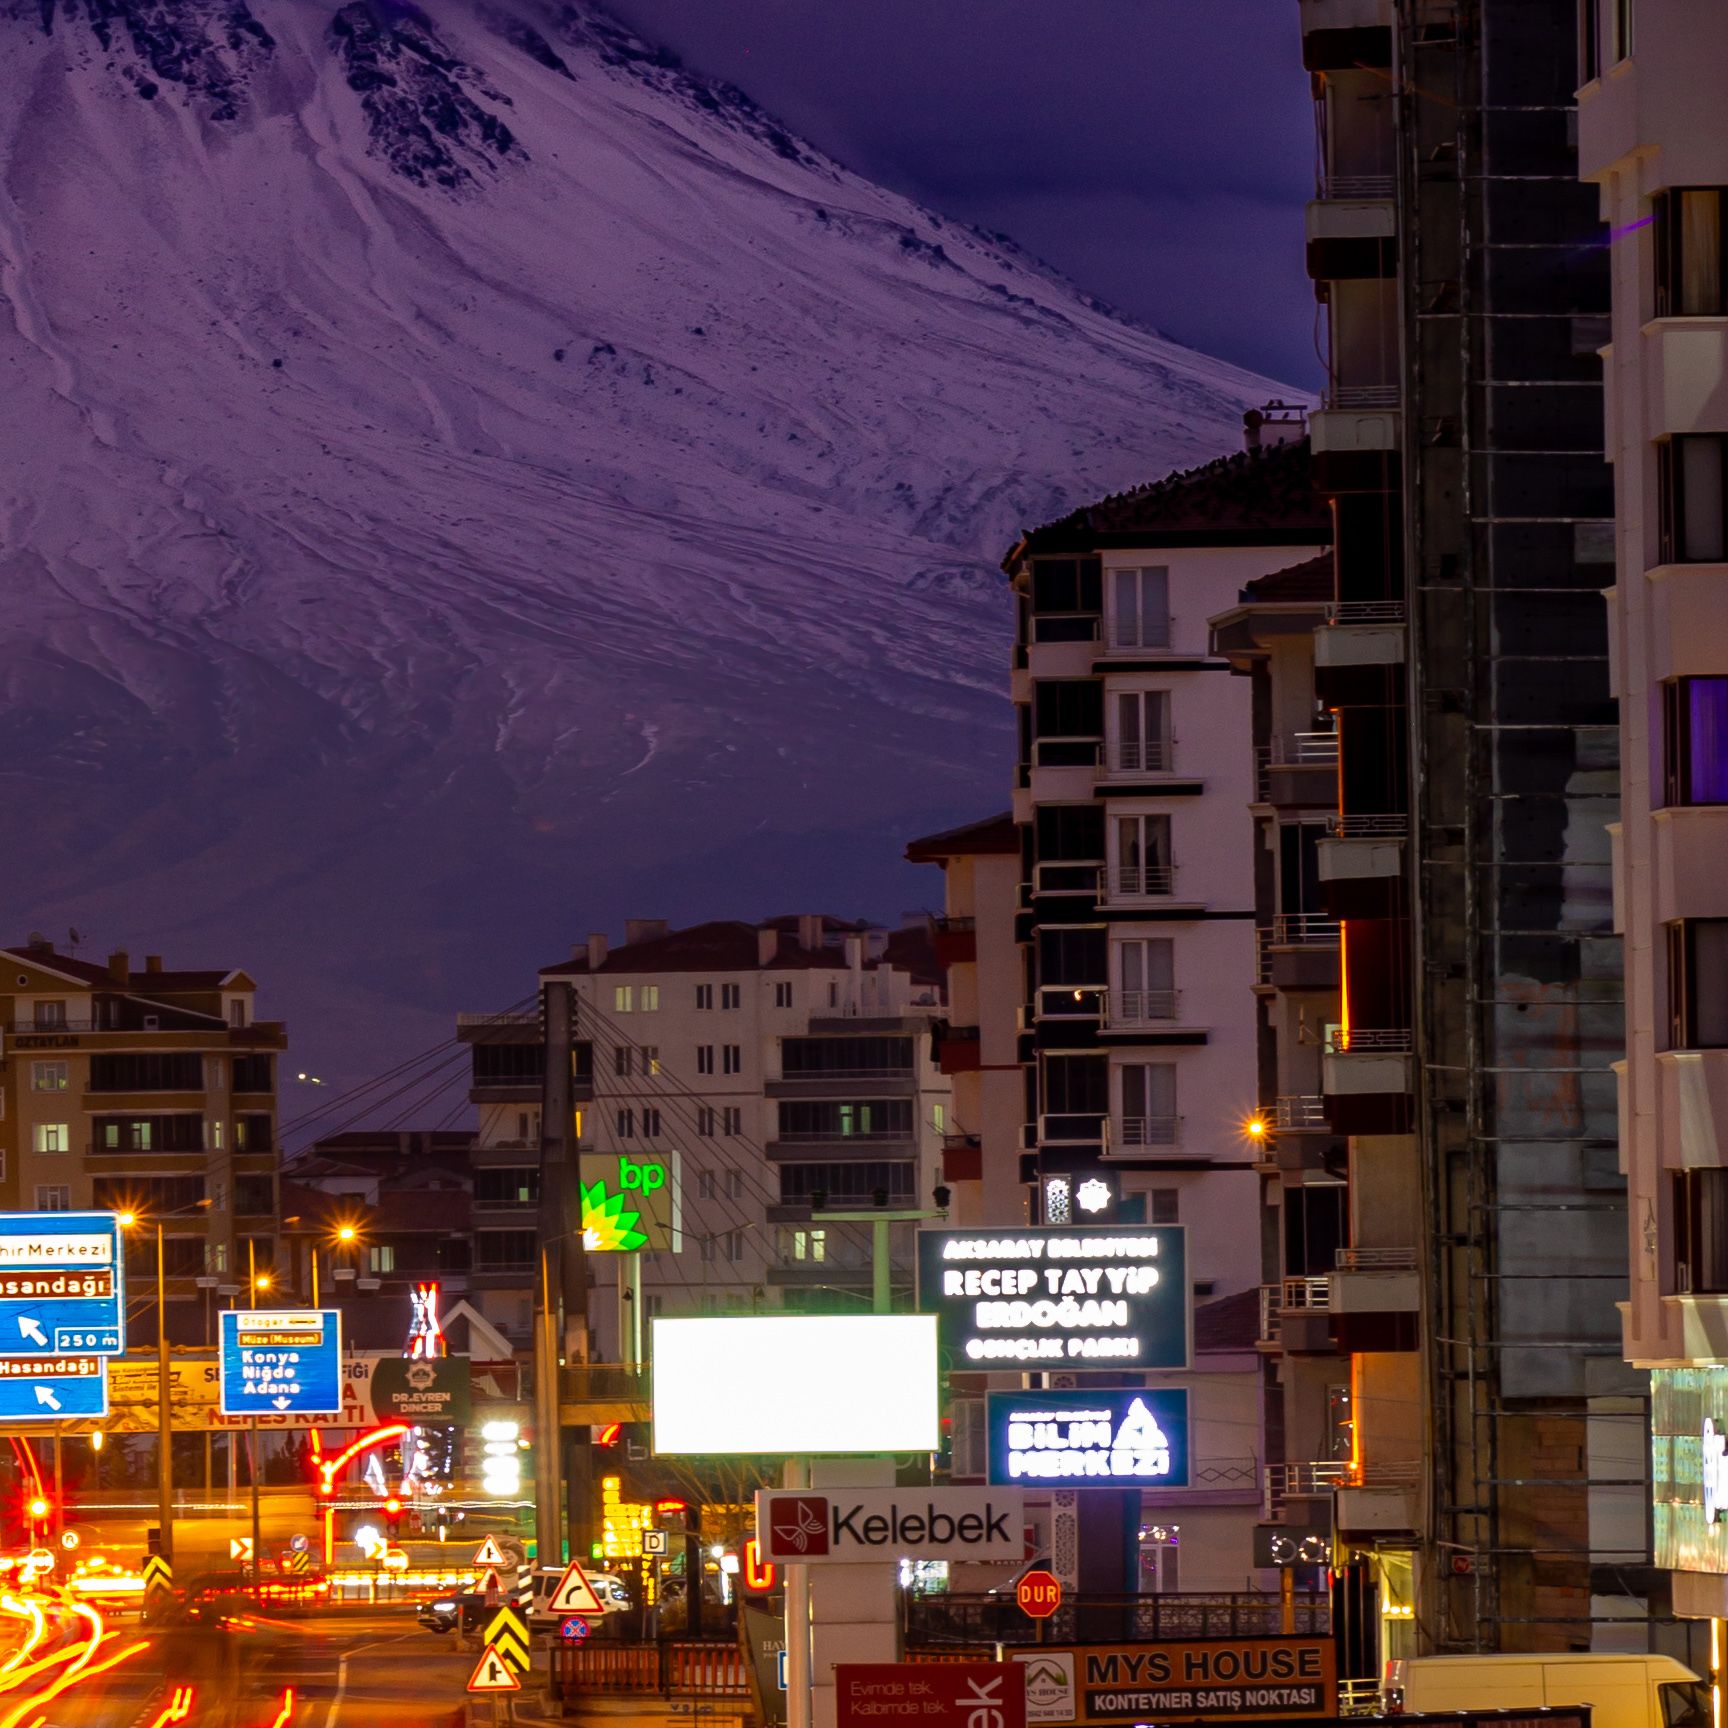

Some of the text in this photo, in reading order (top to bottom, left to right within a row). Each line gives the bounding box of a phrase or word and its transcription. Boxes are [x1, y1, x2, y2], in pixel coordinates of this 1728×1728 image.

[618, 1155, 666, 1199] bp
[28, 1243, 107, 1257] Merkezi
[943, 1268, 1039, 1296] RECEP
[60, 1334, 118, 1347] 250 m
[241, 1350, 300, 1366] Konya
[242, 1380, 301, 1394] Adana
[832, 1502, 1012, 1546] Kelebek
[1021, 1584, 1057, 1604] DUR
[1086, 1647, 1322, 1685] MYS HOUSE
[851, 1680, 905, 1696] Evimde
[851, 1700, 920, 1715] Kalbimde
[1093, 1688, 1316, 1711] KONTEYNER SATIŞ NOKTASI
